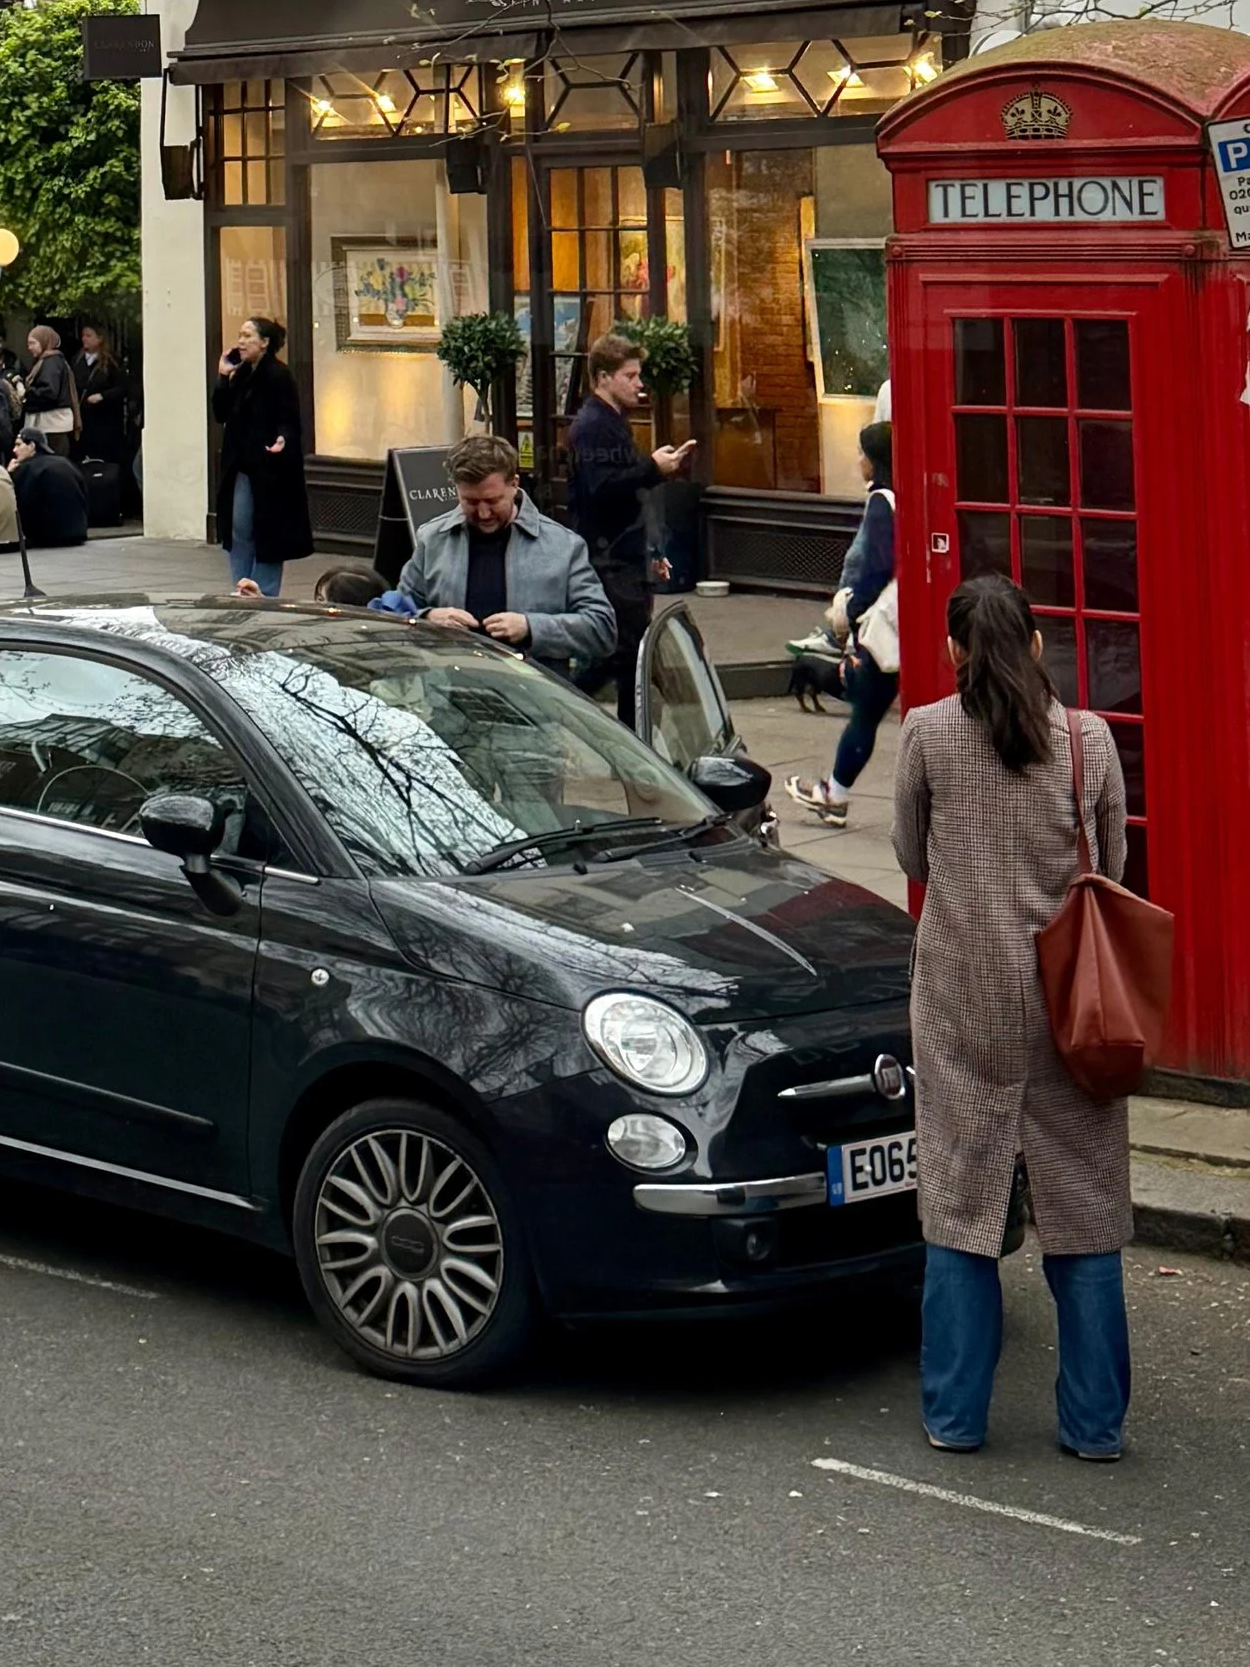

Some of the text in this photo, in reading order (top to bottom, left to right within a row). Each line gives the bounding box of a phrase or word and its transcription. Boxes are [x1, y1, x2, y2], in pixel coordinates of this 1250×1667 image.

[1226, 142, 1248, 169] P
[934, 179, 1159, 219] TELEPHONE
[409, 486, 456, 502] CLAREN
